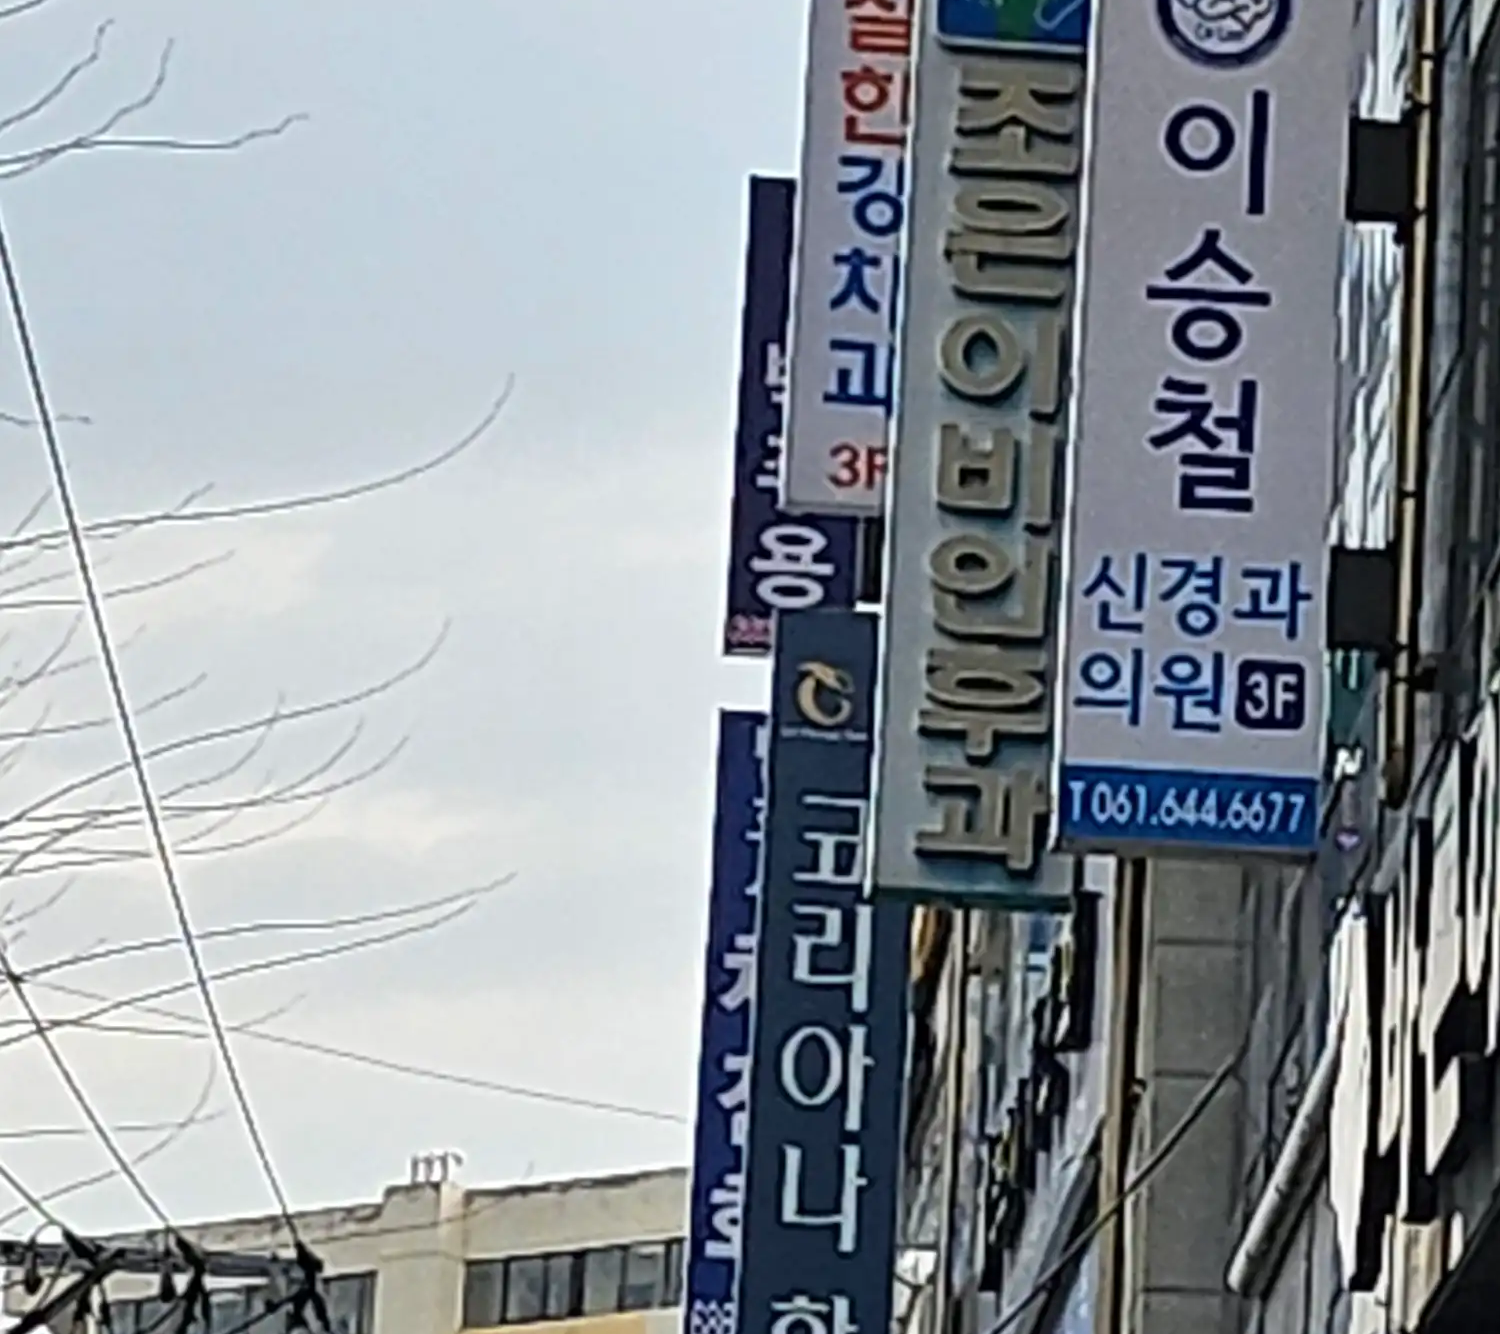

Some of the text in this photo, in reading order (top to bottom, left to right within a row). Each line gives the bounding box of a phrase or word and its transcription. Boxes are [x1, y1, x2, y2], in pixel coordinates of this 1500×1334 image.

[1145, 89, 1272, 515] 이승철
[914, 65, 1083, 875] 조은이비인후과
[1082, 551, 1314, 641] 신경과
[1072, 646, 1225, 733] 의원
[1243, 670, 1299, 723] 3F
[780, 793, 878, 1255] 코리아나
